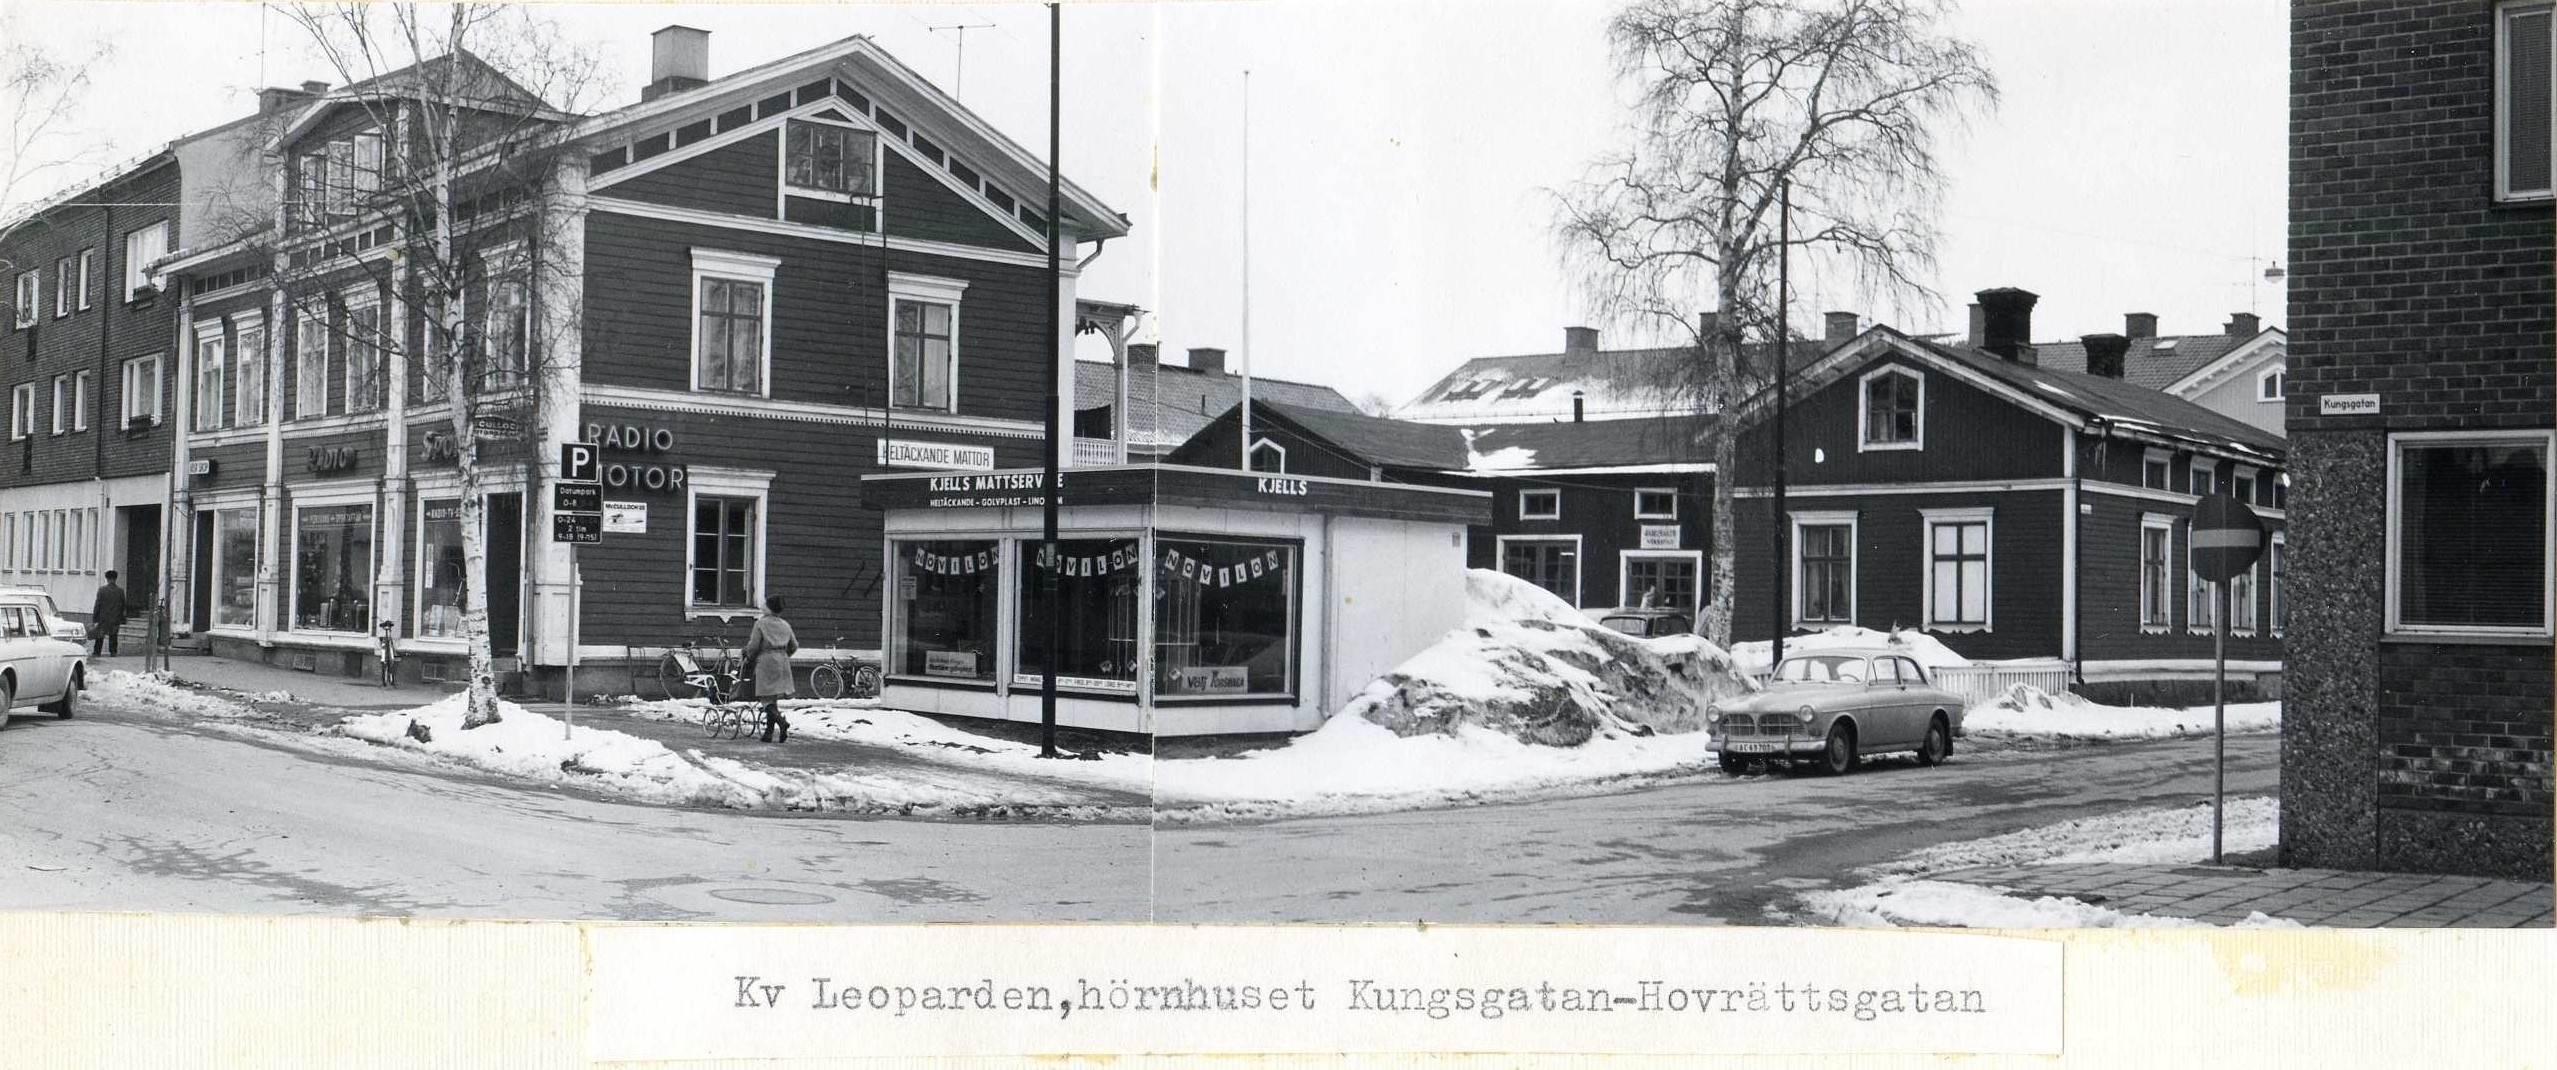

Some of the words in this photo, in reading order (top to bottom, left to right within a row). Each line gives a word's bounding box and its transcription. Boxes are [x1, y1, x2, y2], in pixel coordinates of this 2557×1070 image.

[2324, 399, 2376, 411] Kungsgatan
[588, 423, 674, 450] RADIO
[572, 447, 589, 478] P
[882, 443, 949, 464] HELTÄCKANDE
[953, 450, 990, 467] MATTOR
[597, 464, 684, 489] OTOR
[930, 476, 970, 491] KJELLS
[975, 473, 1063, 491] MATTSERVE
[1258, 477, 1307, 495] KJELLS
[560, 487, 596, 496] Datumpark
[930, 497, 974, 507] HELTÄCKANDE
[982, 497, 1021, 506] GOLVPLAST
[1028, 496, 1063, 506] LINOM
[915, 548, 999, 574] NOVILON
[1166, 551, 1277, 585] NOVILON
